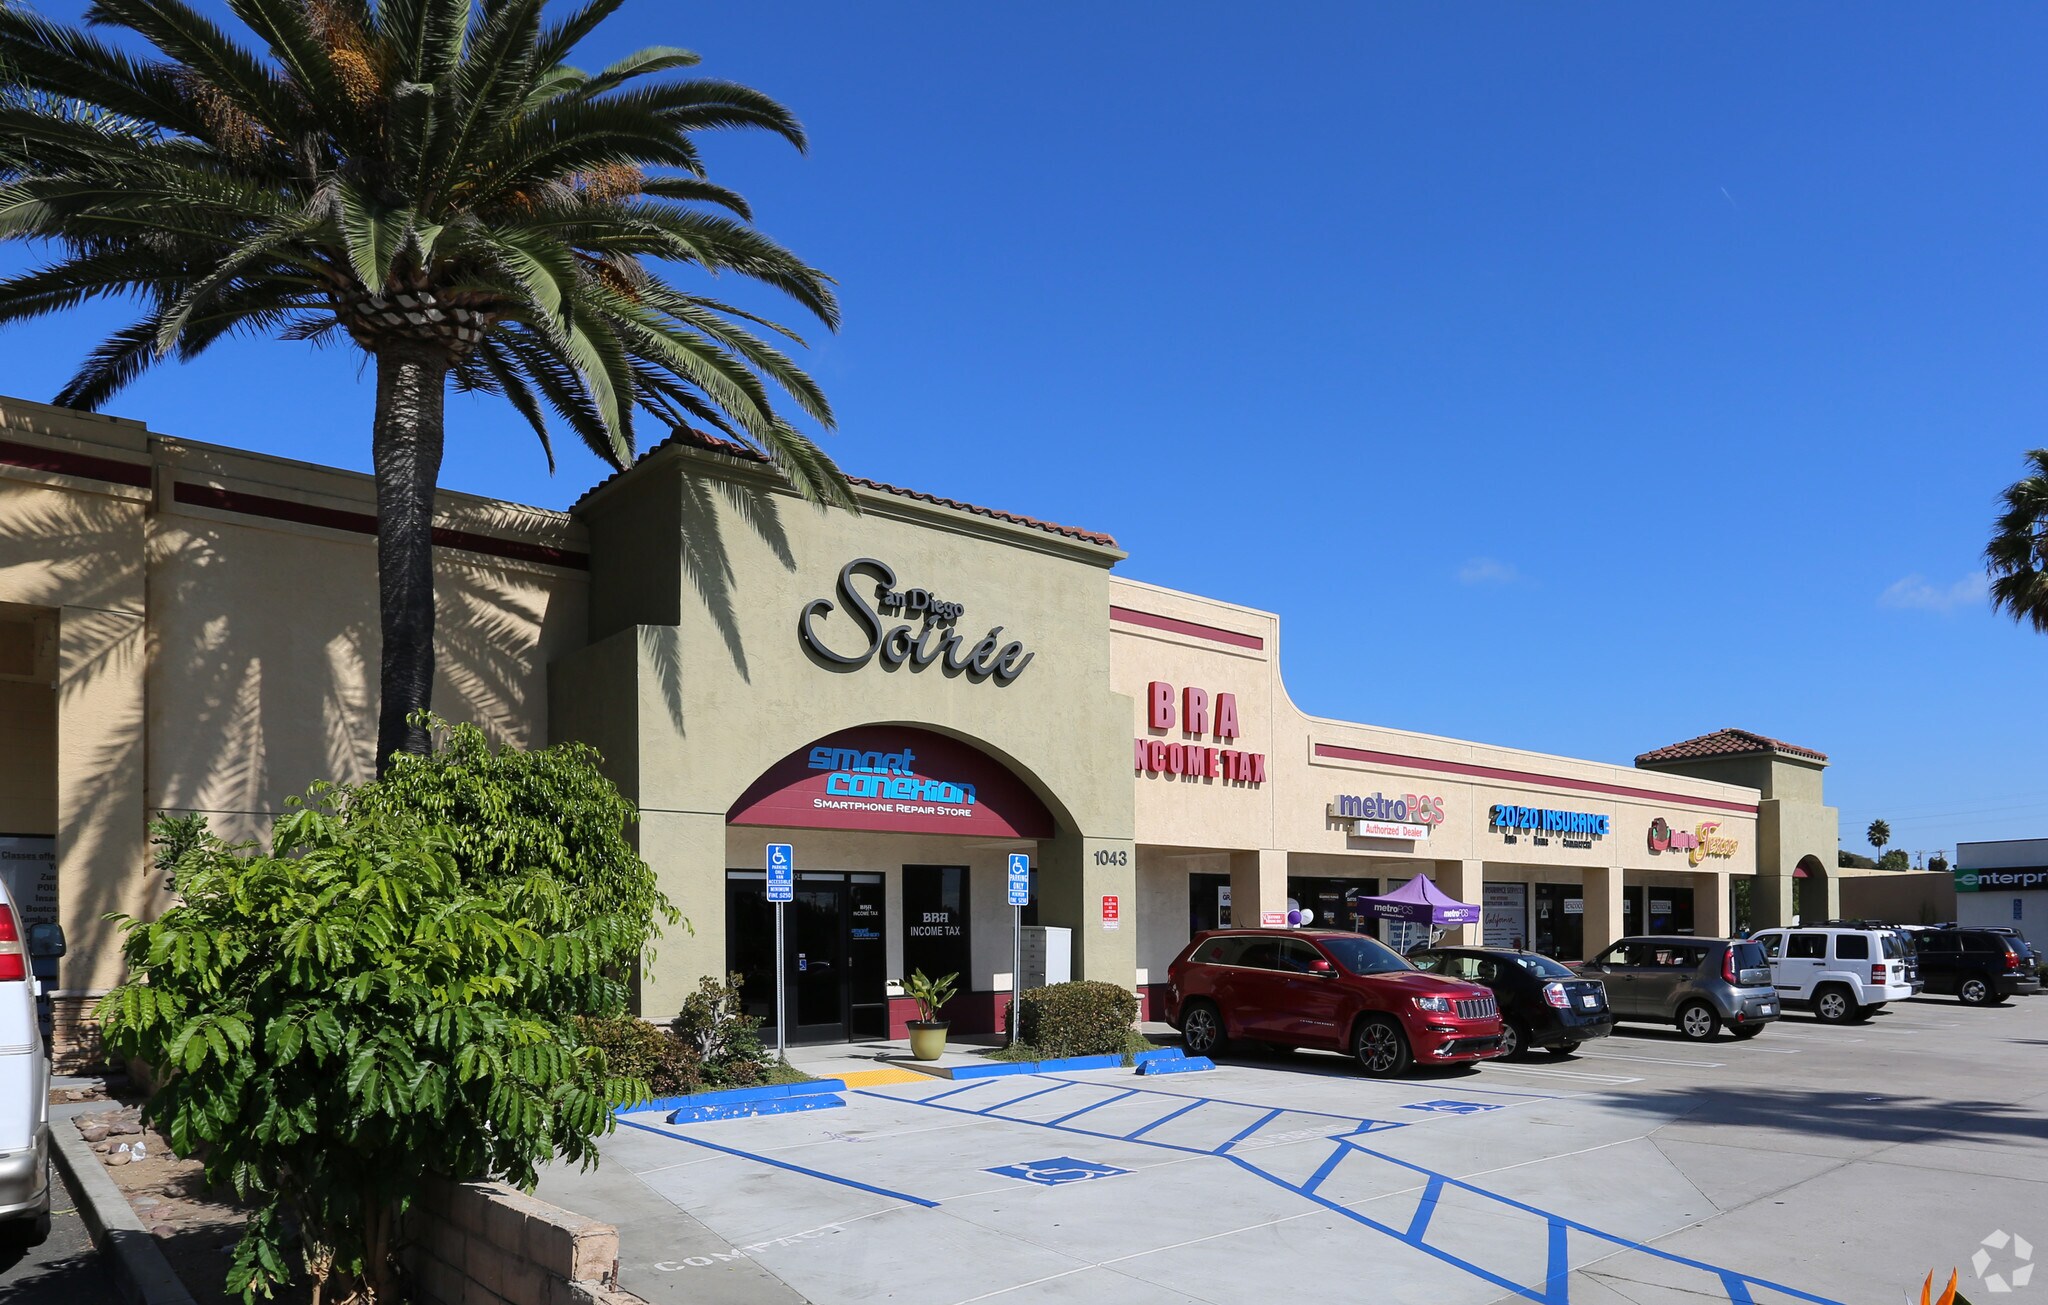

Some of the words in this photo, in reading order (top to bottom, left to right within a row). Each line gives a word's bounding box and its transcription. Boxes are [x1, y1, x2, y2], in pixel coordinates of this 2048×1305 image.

[911, 588, 964, 618] Diego
[1148, 681, 1240, 738] BRA
[1134, 738, 1220, 778] NCOME
[1221, 750, 1266, 783] TAX
[813, 798, 893, 813] SMARTPHONE
[896, 803, 935, 815] REPAIR
[936, 805, 972, 818] STORE
[1339, 792, 1445, 825] metroPCS
[1495, 804, 1539, 829] 20/20
[1542, 809, 1610, 835] INSURANCE
[1365, 823, 1400, 837] Authorized
[1403, 825, 1423, 838] Dealer
[1504, 834, 1517, 845] Auto
[1533, 836, 1549, 847] Home
[2, 851, 37, 861] Classes
[1094, 850, 1128, 867] 1043
[1957, 872, 2048, 887] enterpr
[1374, 904, 1413, 915] metroPCS
[1443, 908, 1468, 918] metroPCS
[922, 912, 949, 923] BRA
[910, 926, 943, 936] INCOME
[945, 926, 960, 936] TAX
